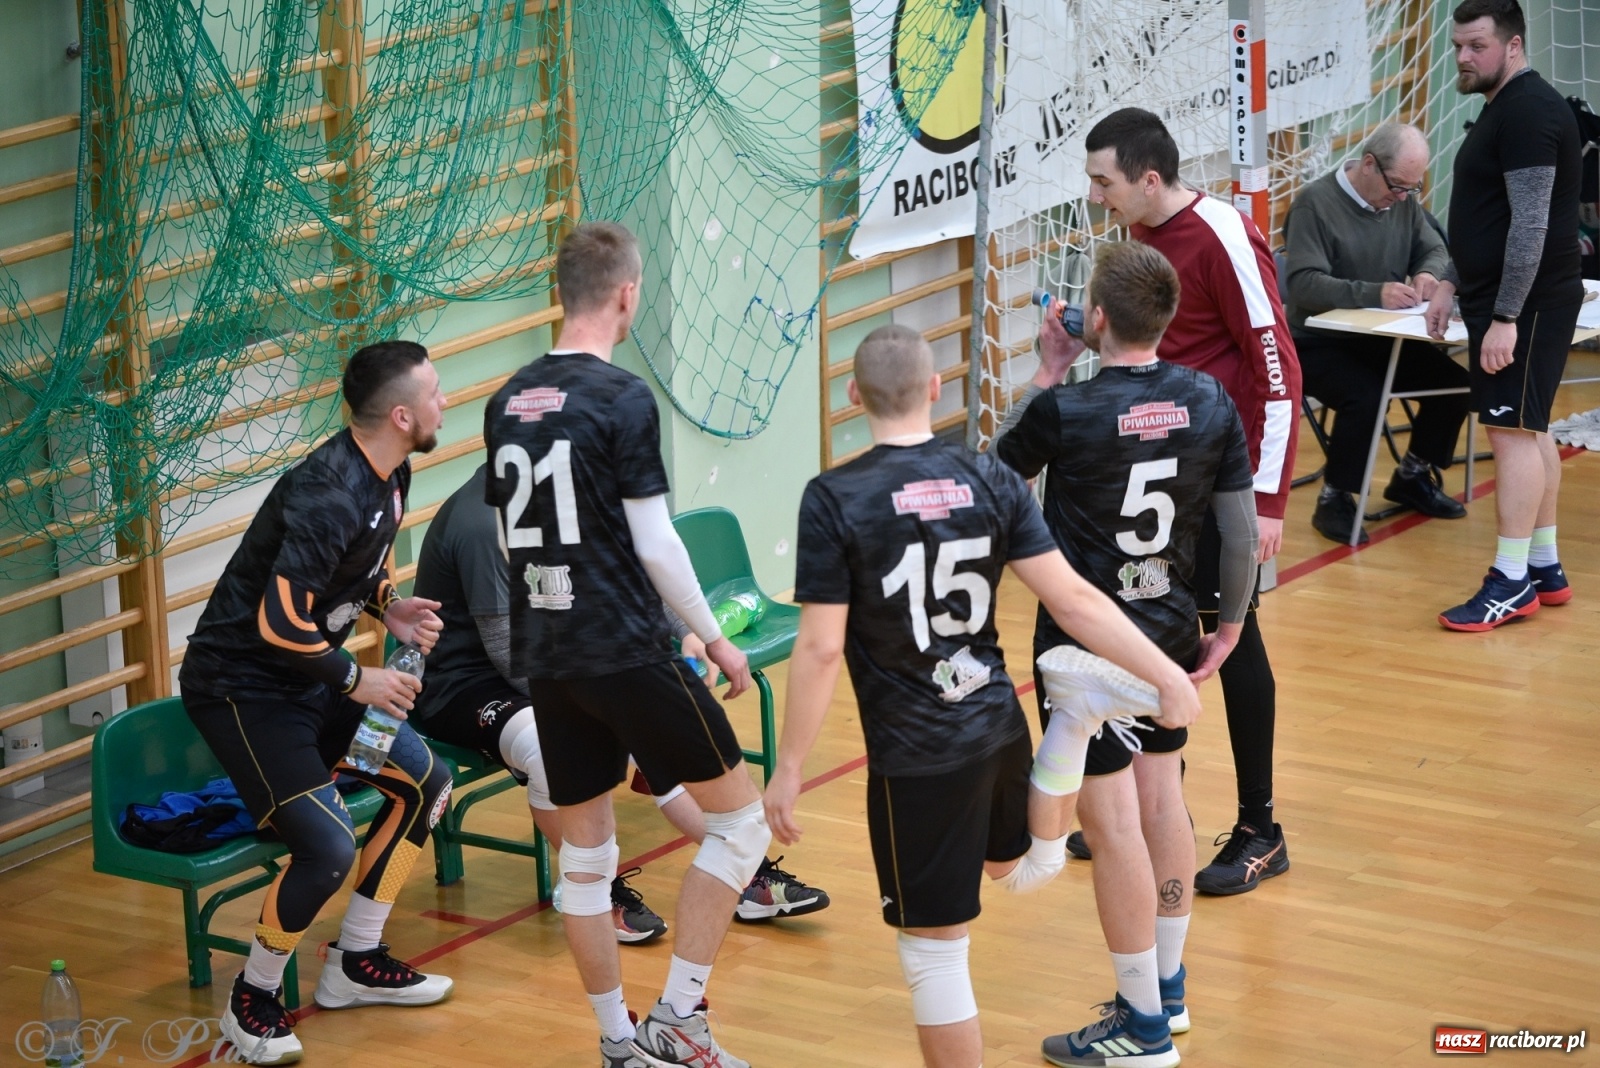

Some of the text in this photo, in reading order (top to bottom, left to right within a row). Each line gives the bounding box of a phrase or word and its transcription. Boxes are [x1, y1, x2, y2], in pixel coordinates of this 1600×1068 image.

[1236, 96, 1246, 162] sport
[510, 397, 559, 410] PIWIARNIA
[1123, 411, 1185, 431] PIWIARNIA
[495, 439, 581, 549] 21
[899, 491, 967, 508] PIWIARNIA
[1115, 457, 1178, 557] 5
[881, 535, 991, 653] 15
